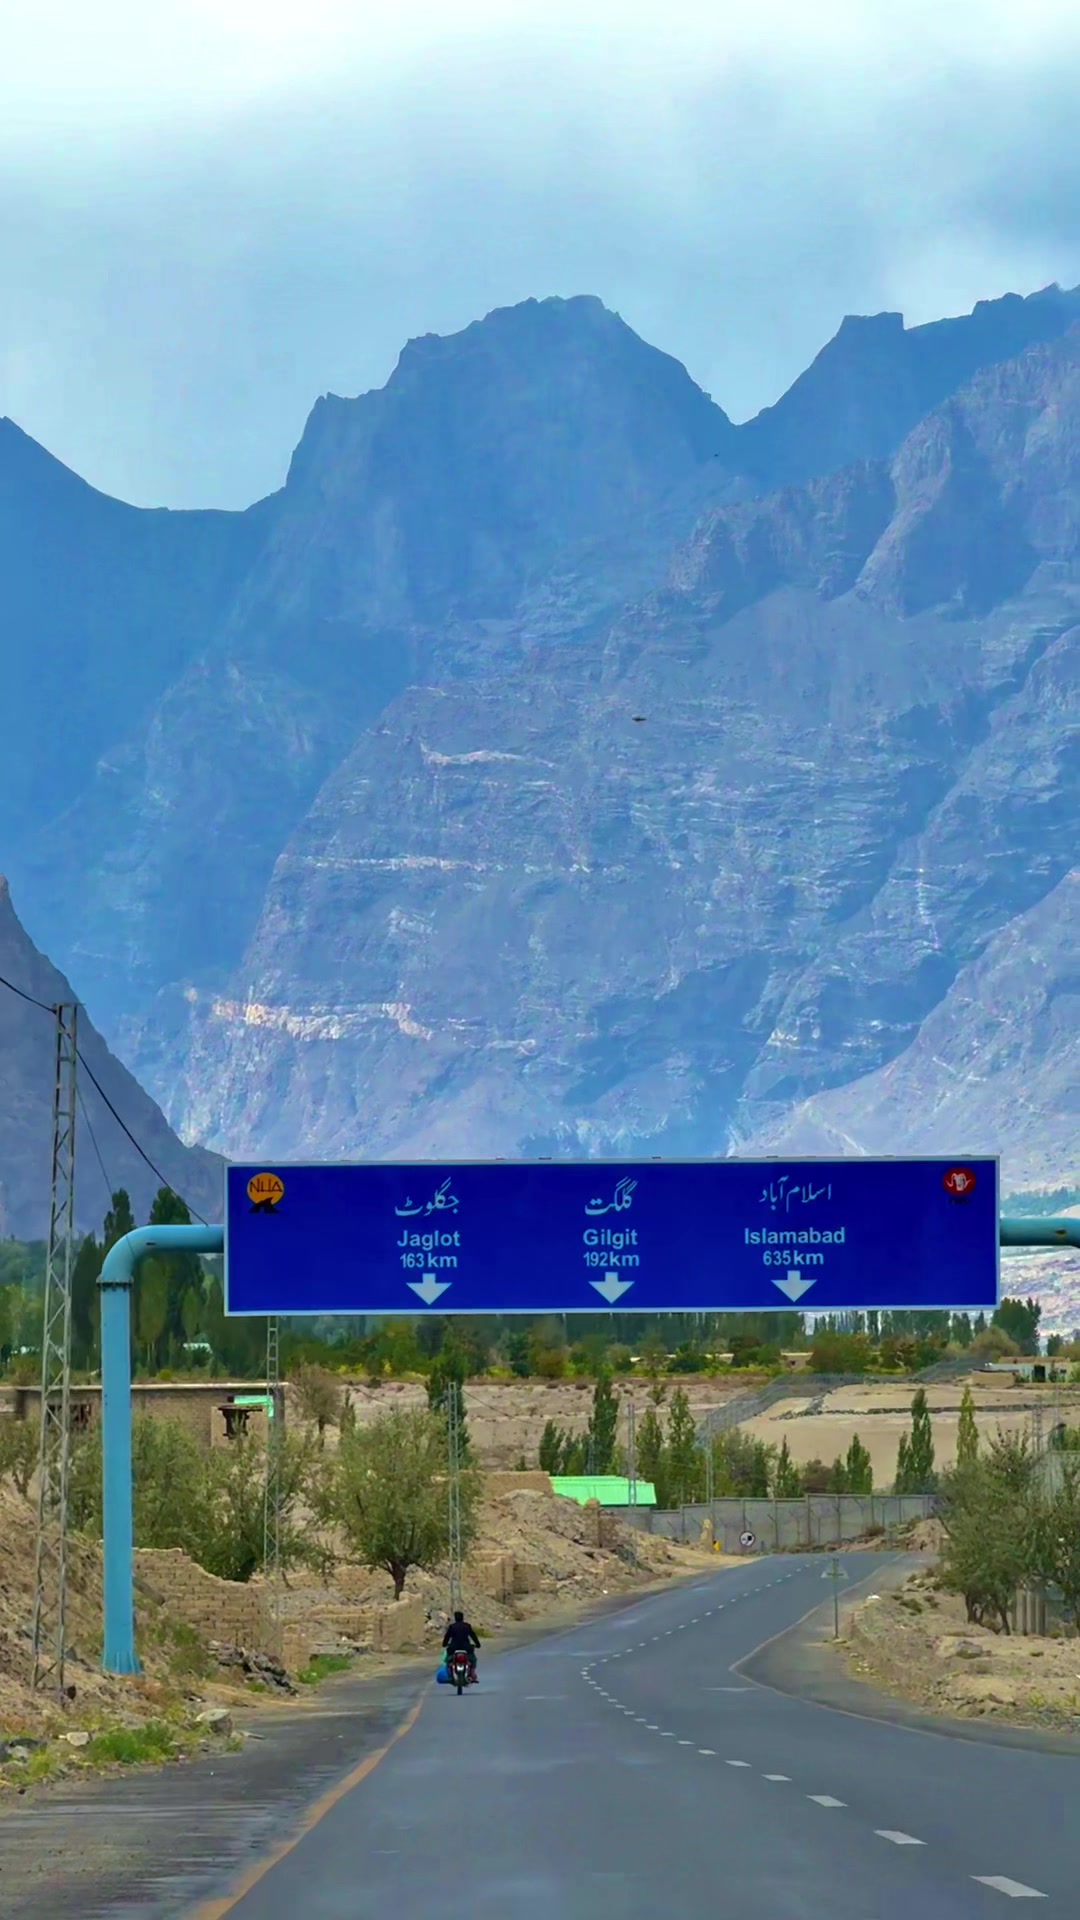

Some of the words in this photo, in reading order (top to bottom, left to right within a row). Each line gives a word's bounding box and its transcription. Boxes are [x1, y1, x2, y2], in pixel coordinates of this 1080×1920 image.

[584, 1176, 638, 1216] گلگت
[759, 1175, 789, 1211] آباد
[785, 1183, 832, 1213] اسلام
[396, 1229, 461, 1251] Jaglot
[583, 1228, 638, 1250] Gilgit
[744, 1226, 846, 1245] Islamabad
